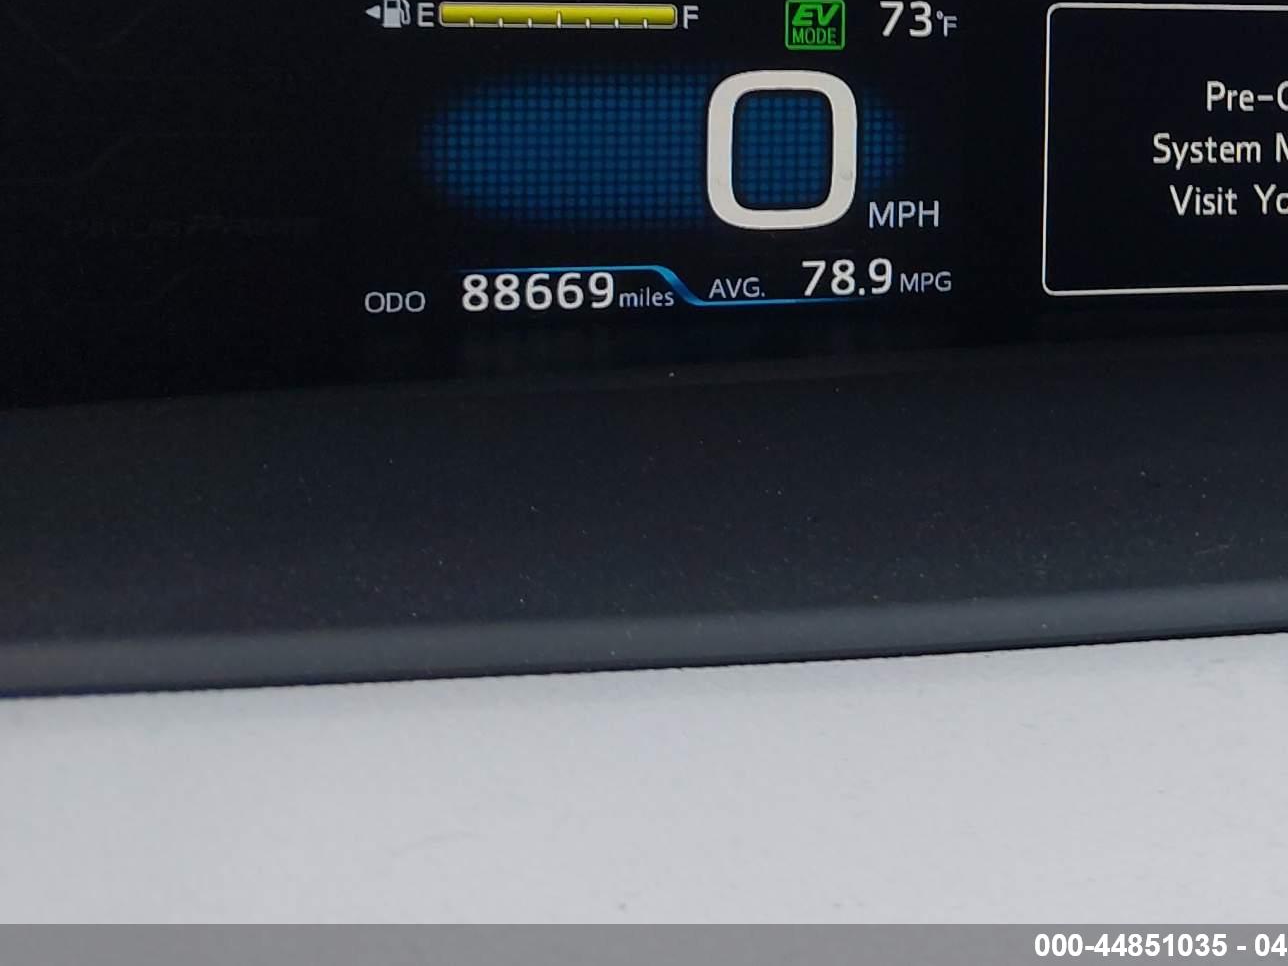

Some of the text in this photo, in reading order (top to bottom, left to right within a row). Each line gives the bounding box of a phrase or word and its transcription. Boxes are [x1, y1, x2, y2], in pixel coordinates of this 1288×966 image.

[417, 3, 435, 28] E
[683, 5, 699, 29] F
[792, 4, 835, 26] EV
[793, 28, 837, 47] MODE
[707, 70, 858, 230] 0
[1153, 132, 1261, 170] System
[868, 200, 940, 229] MPH
[1169, 184, 1238, 216] Visit
[709, 257, 952, 299] AVG. 78.9 MPG
[364, 273, 675, 314] ODO 88669 miles
